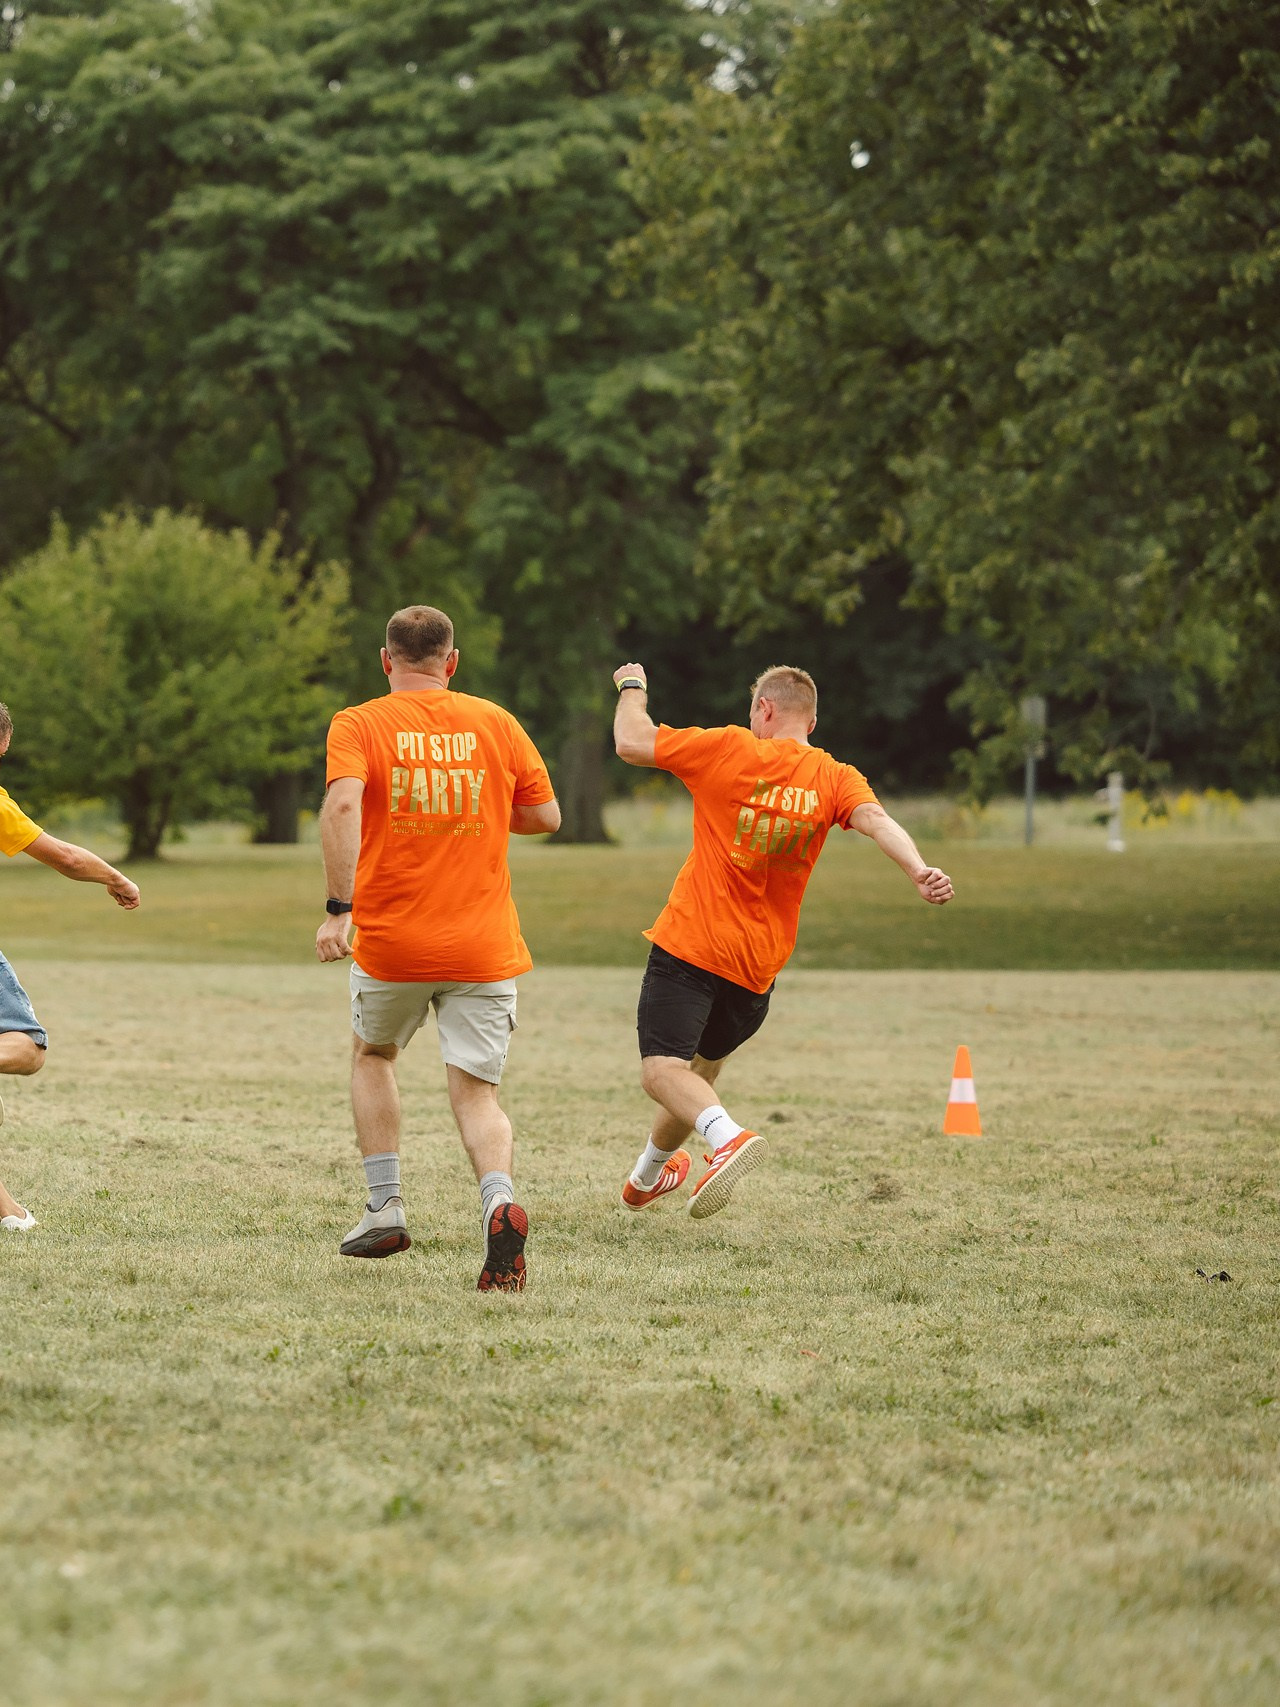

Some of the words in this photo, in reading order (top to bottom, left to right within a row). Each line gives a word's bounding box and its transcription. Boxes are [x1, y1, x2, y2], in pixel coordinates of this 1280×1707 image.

[396, 731, 426, 760] PIT
[429, 731, 477, 762] STOP
[390, 766, 486, 815] PARTY
[749, 778, 782, 808] PIT
[391, 820, 418, 828] WHERE
[733, 805, 824, 859] PARTY
